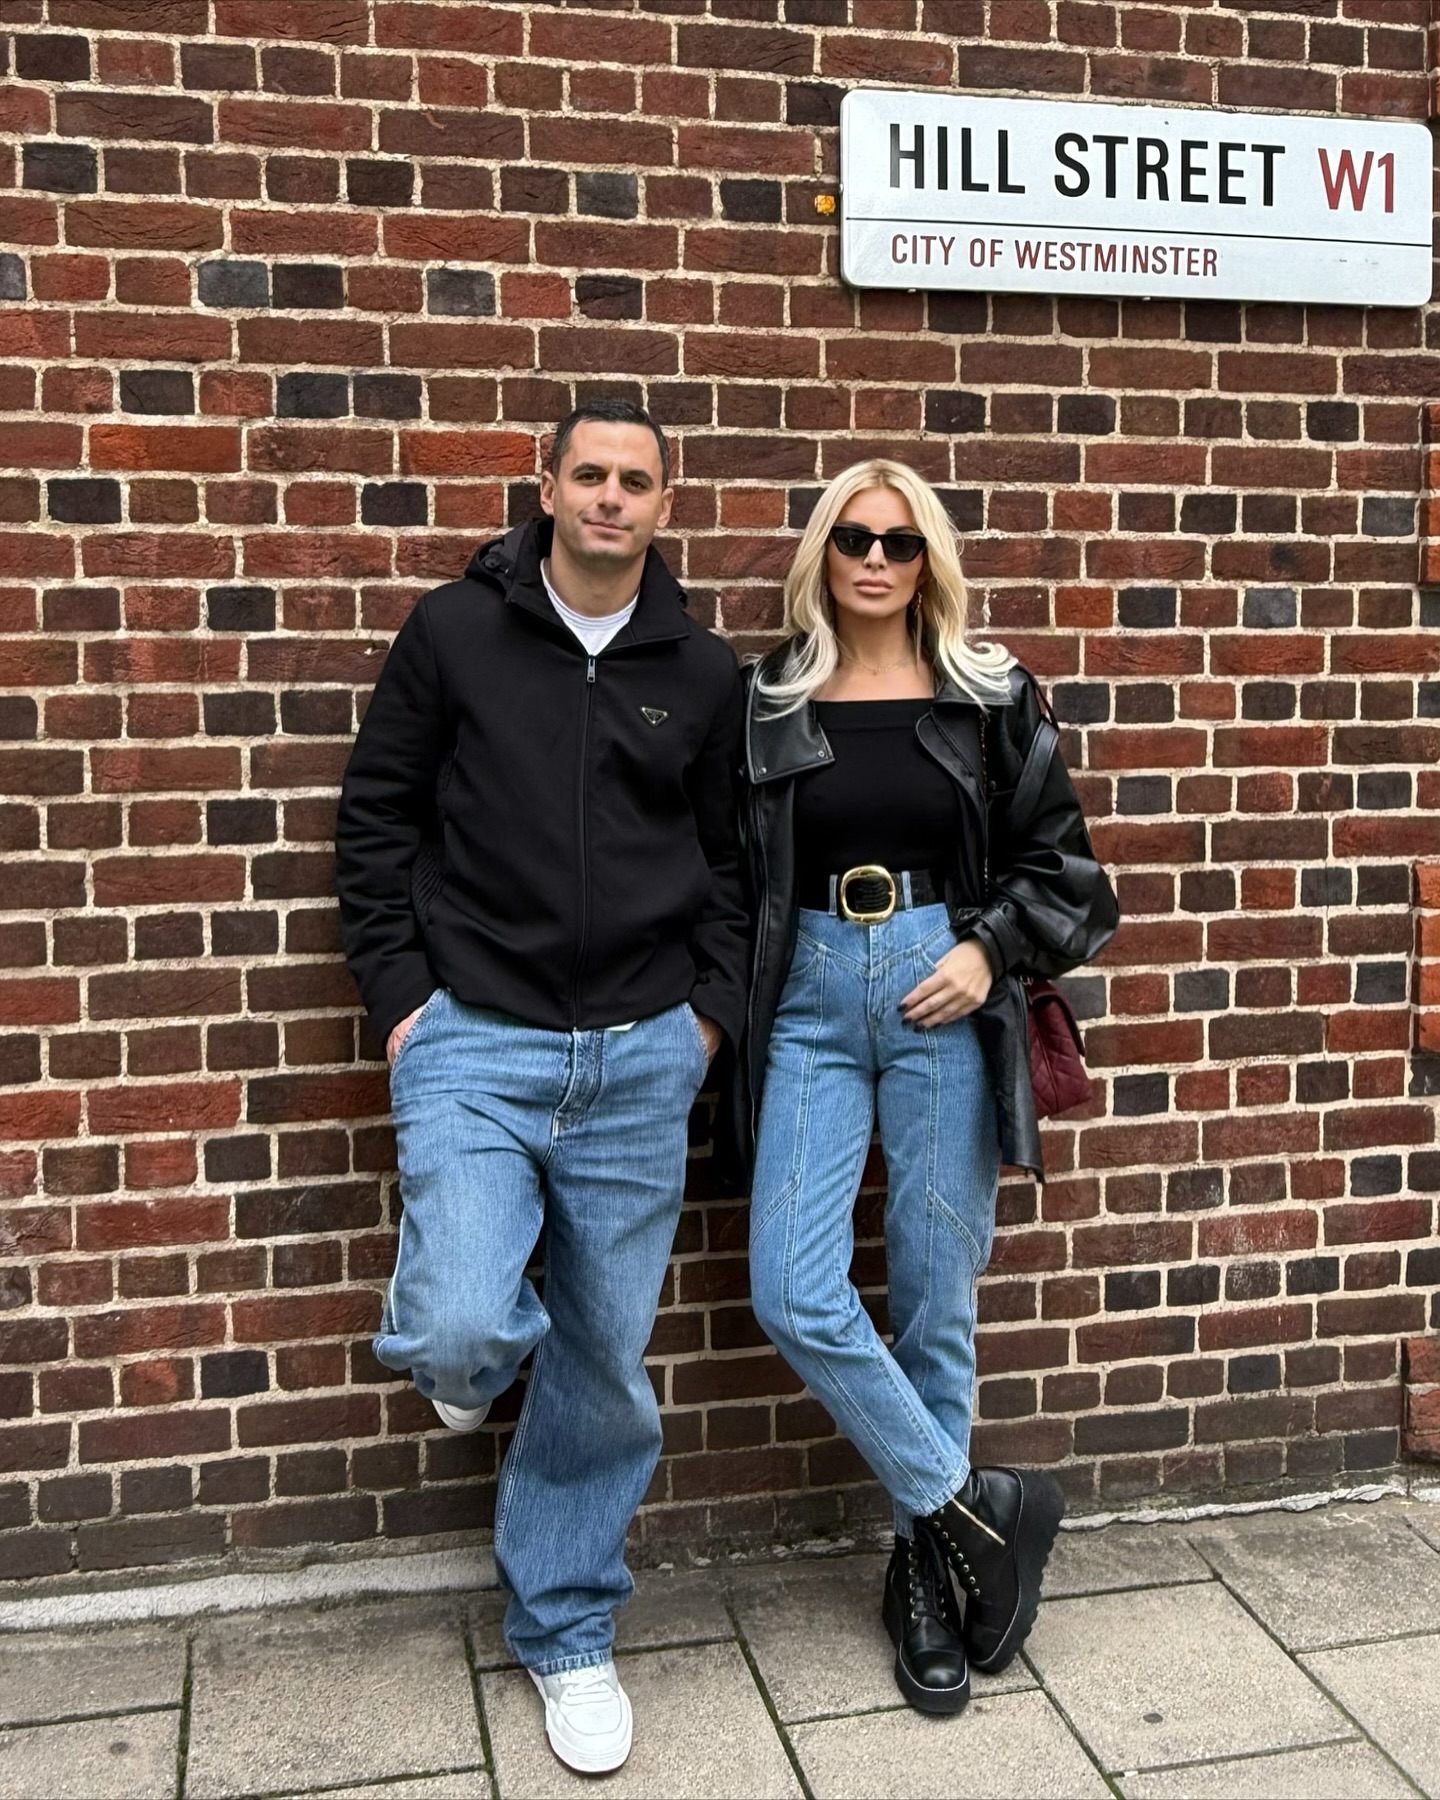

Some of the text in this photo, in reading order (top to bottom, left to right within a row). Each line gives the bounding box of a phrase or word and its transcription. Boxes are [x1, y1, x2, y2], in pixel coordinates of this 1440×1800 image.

[889, 123, 1396, 214] HILL STREET W1
[891, 234, 1219, 278] CITY OF WESTMINSTER
